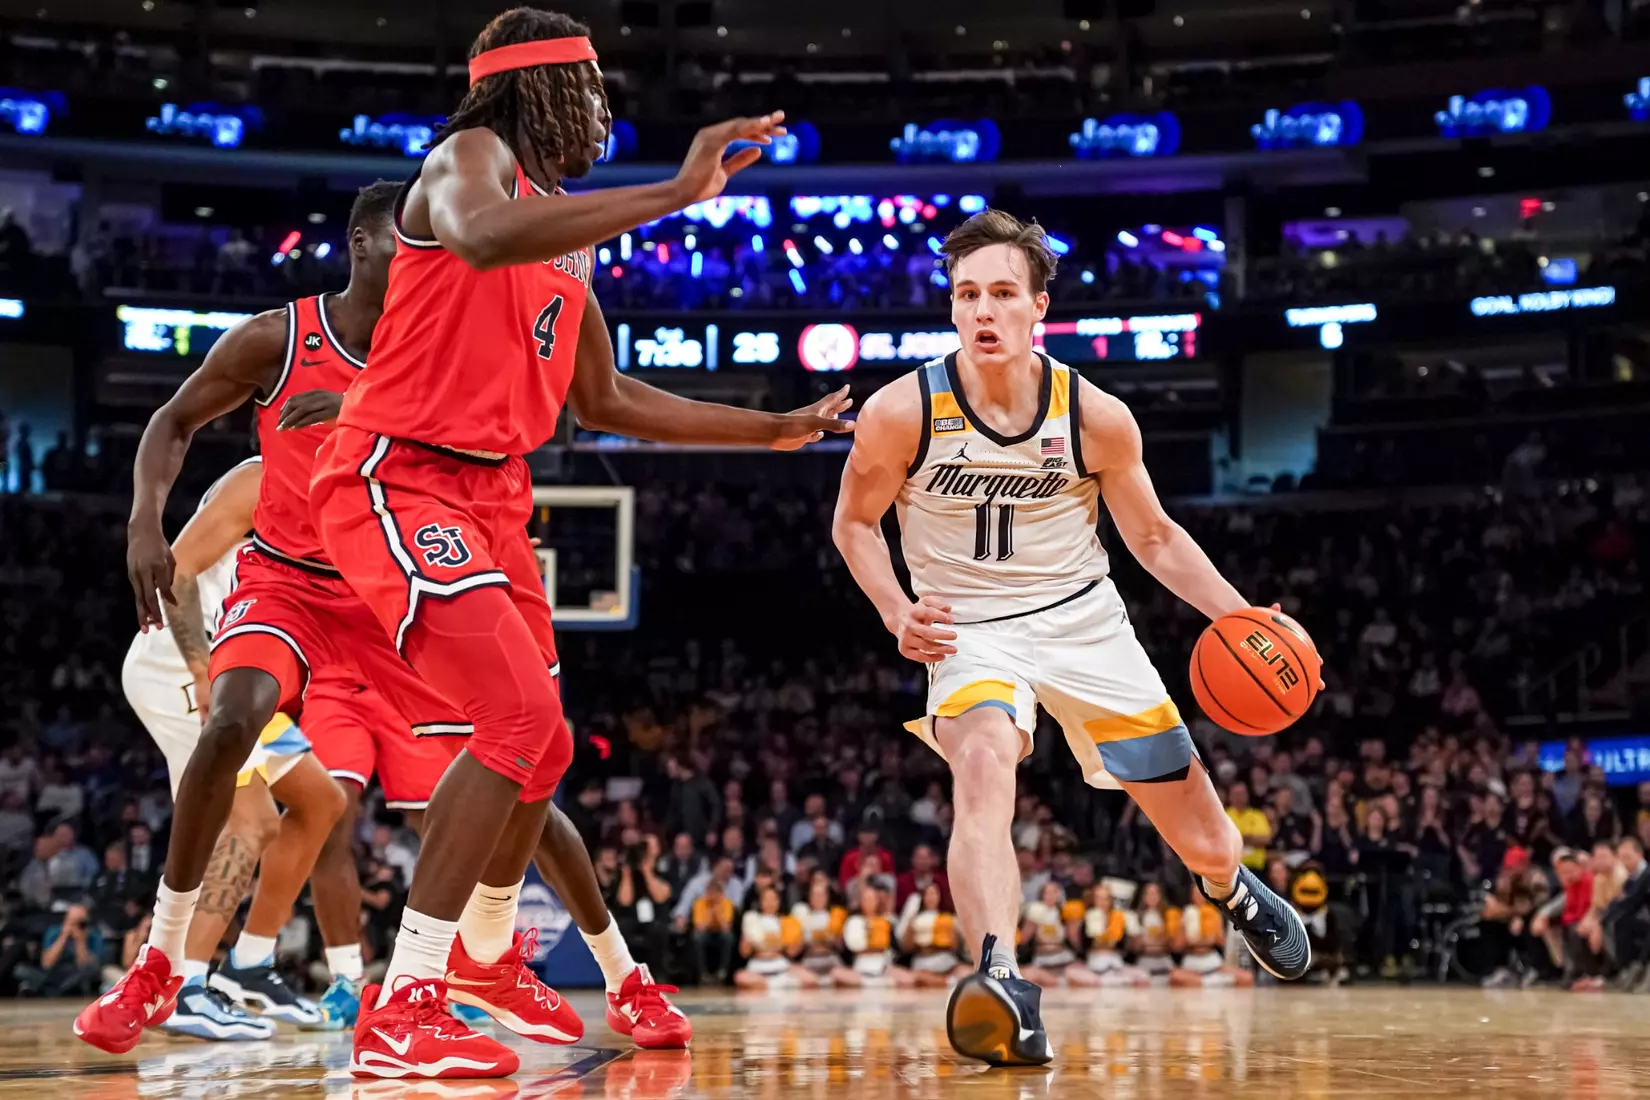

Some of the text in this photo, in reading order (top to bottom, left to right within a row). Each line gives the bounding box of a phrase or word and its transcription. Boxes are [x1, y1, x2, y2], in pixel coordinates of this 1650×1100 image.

[305, 335, 321, 347] JK
[533, 294, 563, 360] 4
[925, 464, 1069, 501] Marquette
[414, 522, 472, 568] SJ
[973, 503, 1014, 561] 11
[1244, 630, 1300, 691] ELITE
